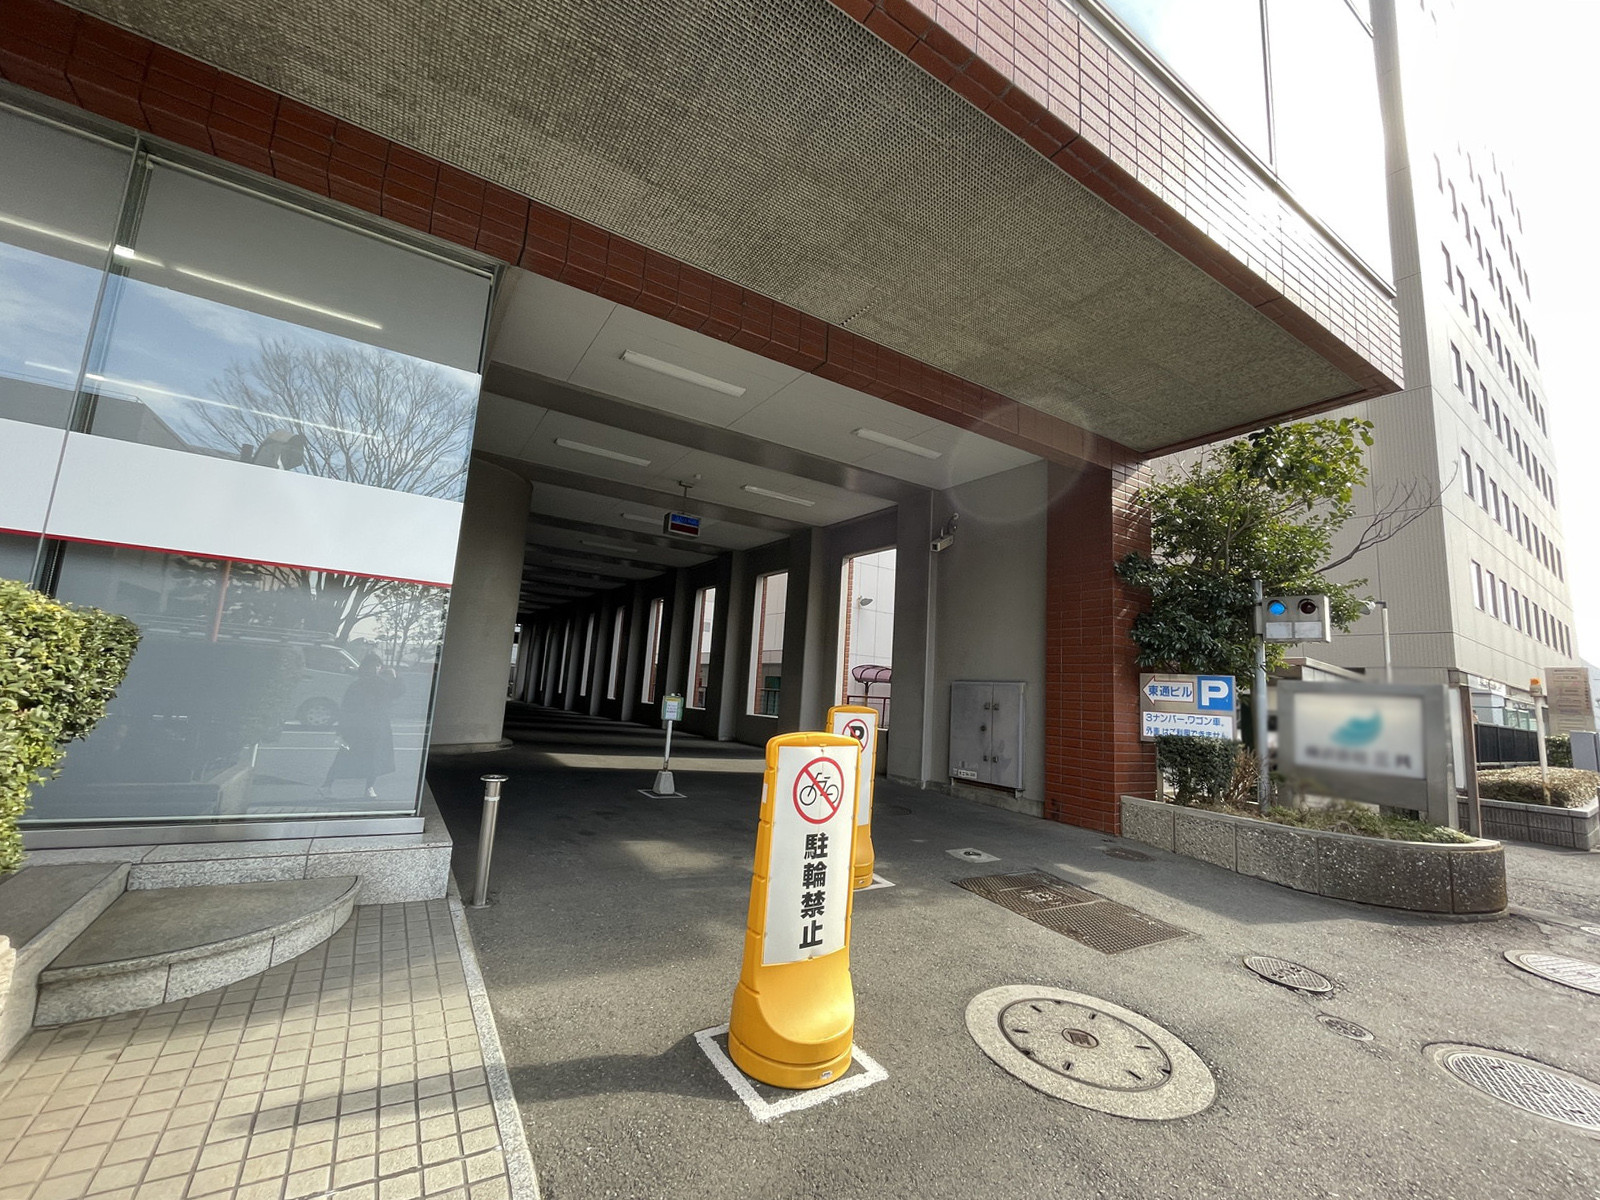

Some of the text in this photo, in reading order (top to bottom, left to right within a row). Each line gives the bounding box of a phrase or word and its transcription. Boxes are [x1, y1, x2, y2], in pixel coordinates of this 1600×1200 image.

[1148, 684, 1193, 698] 東通ビル
[1200, 679, 1230, 707] P
[799, 832, 829, 949] 駐輪禁止
